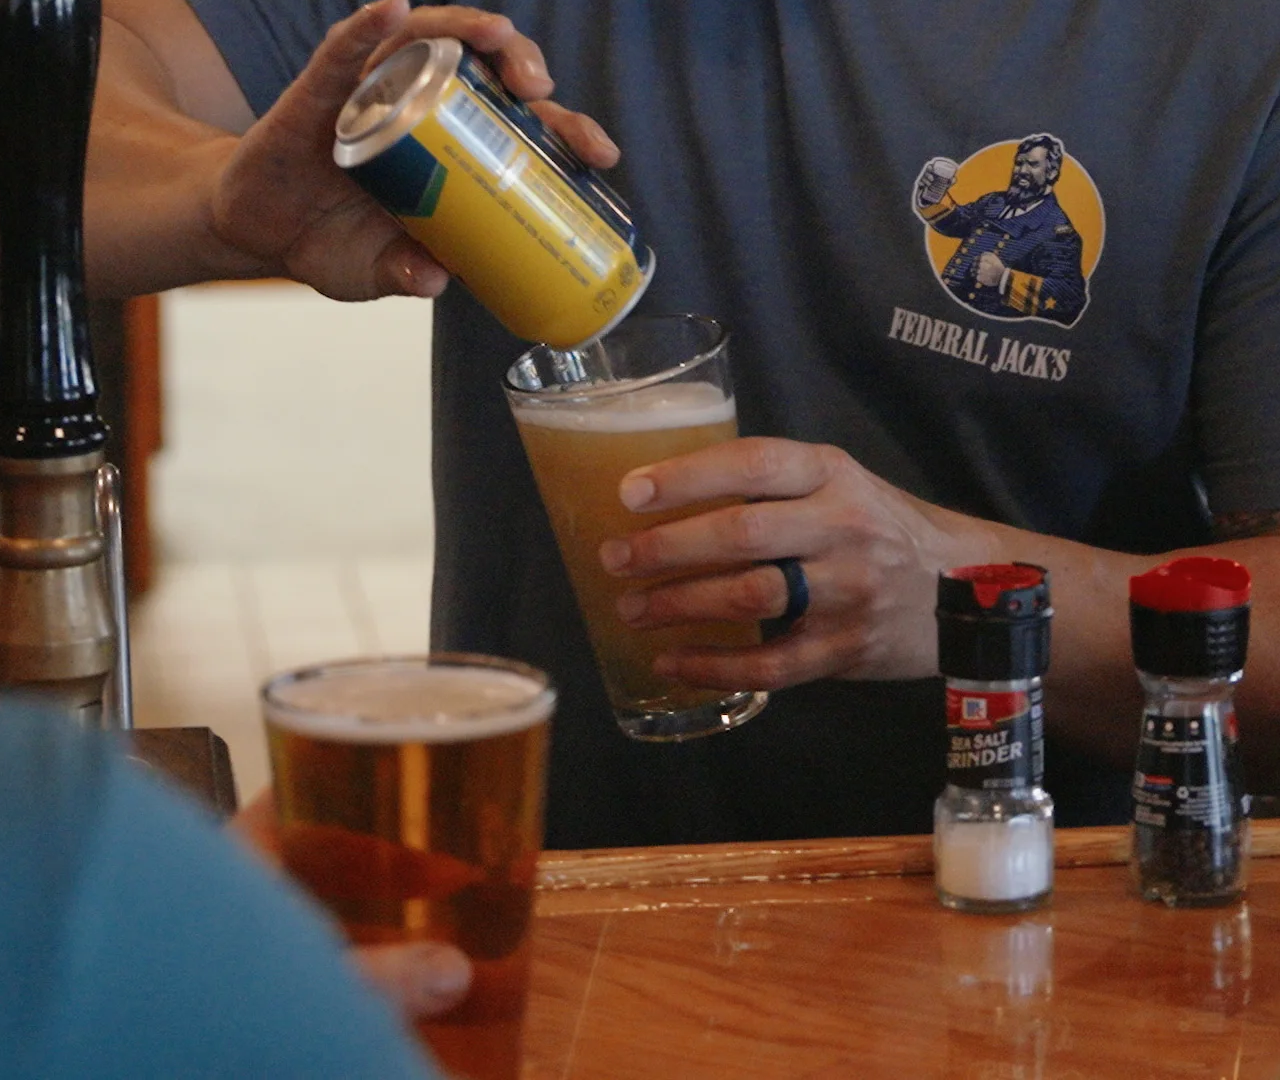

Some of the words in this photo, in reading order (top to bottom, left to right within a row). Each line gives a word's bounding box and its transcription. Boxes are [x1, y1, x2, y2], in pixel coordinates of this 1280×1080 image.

[888, 307, 989, 366] FEDERAL
[991, 337, 1071, 381] JACK'S
[973, 730, 1009, 750] SALT
[946, 741, 1023, 769] RINDER
